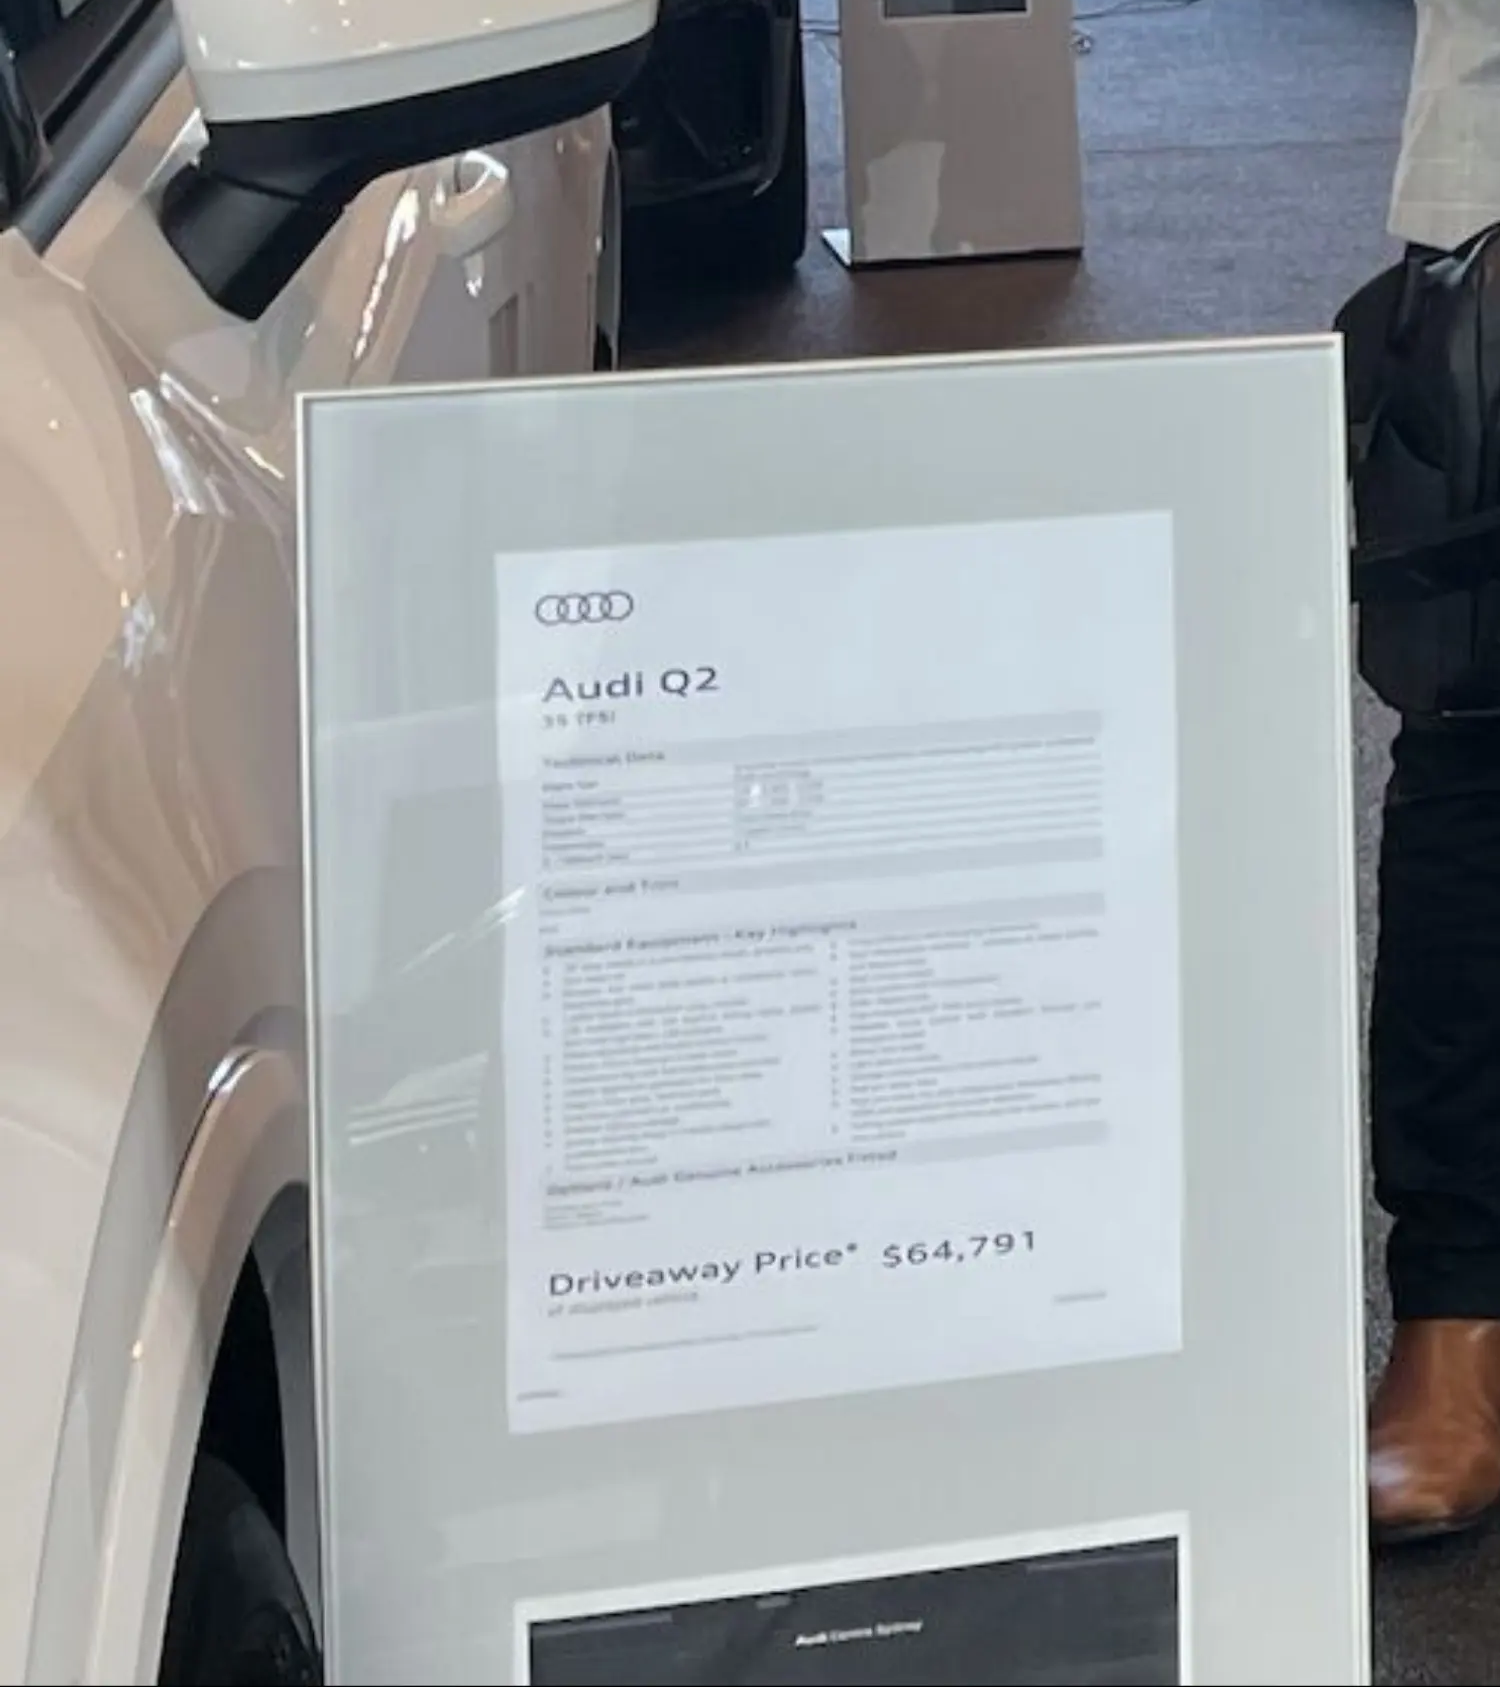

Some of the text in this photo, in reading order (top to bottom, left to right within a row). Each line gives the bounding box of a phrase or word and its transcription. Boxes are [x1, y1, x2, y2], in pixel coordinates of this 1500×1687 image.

[541, 665, 721, 704] Audi Q2
[548, 1258, 742, 1298] Driveaway
[881, 1229, 1037, 1269] $64,791
